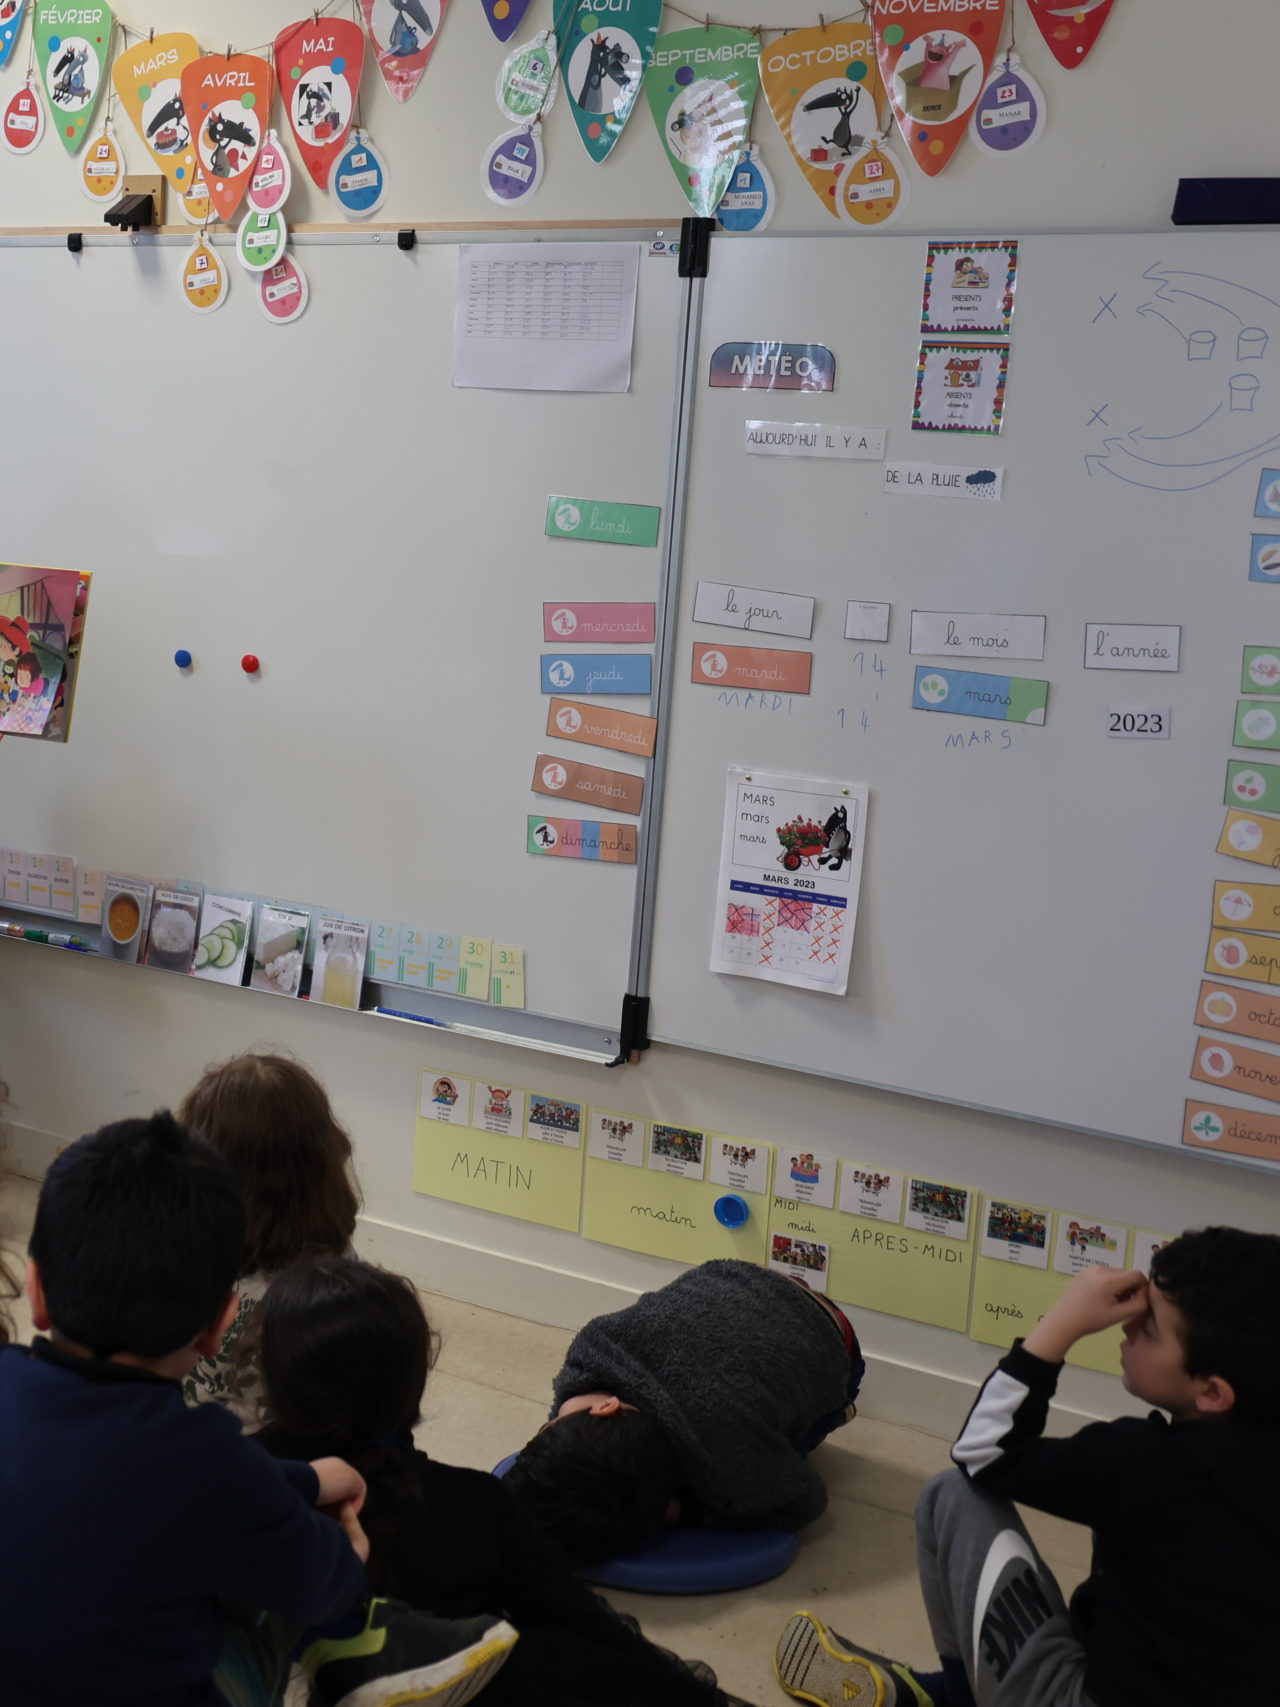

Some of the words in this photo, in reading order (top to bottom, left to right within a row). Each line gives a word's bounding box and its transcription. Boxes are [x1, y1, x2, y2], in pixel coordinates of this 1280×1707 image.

[40, 4, 103, 24] FÉVRIER
[872, 0, 1000, 16] NOVEMBRE
[301, 37, 334, 54] MAI
[132, 48, 179, 78] MARS
[767, 38, 877, 73] OCTOBRE
[531, 62, 538, 71] 6
[201, 71, 255, 88] AVRIL
[999, 88, 1014, 99] 23
[998, 109, 1022, 119] MANAR
[867, 163, 881, 175] 27
[730, 352, 813, 377] MÉTÉO
[945, 392, 973, 400] ABSENTS
[747, 432, 817, 448] AUJOURD'HUI
[825, 435, 835, 448] IL
[844, 436, 851, 449] Y
[858, 437, 868, 449] A
[886, 470, 899, 483] DE
[908, 472, 923, 485] LA
[931, 474, 961, 488] PLUIE
[588, 507, 632, 534] lundi
[723, 589, 740, 613] le
[745, 603, 782, 630] jour
[581, 616, 647, 632] mercredi
[943, 620, 962, 646] le
[969, 632, 1009, 648] mois
[1093, 630, 1170, 659] l'année
[586, 665, 624, 693] jeudi
[735, 663, 786, 681] mardi
[718, 691, 793, 715] MARDI
[965, 690, 1012, 706] mars
[1109, 712, 1163, 734] 2023
[583, 723, 648, 746] vendredi
[945, 729, 1012, 749] MARS
[575, 779, 629, 800] samedi
[743, 792, 775, 807] MARS
[741, 811, 770, 824] mars
[560, 828, 633, 852] dimanche
[739, 833, 767, 844] mars
[763, 873, 789, 885] MARS
[793, 878, 816, 889] 2023
[322, 921, 334, 930] JUS
[343, 925, 366, 935] CITRON
[377, 926, 393, 939] 27
[407, 930, 423, 945] 28
[436, 936, 454, 950] 29
[467, 941, 485, 956] 30
[499, 951, 516, 965] 31
[451, 1152, 532, 1190] MATIN
[774, 1198, 799, 1211] MIDI
[630, 1201, 696, 1229] matin
[787, 1220, 816, 1233] midi
[985, 1302, 1024, 1320] après
